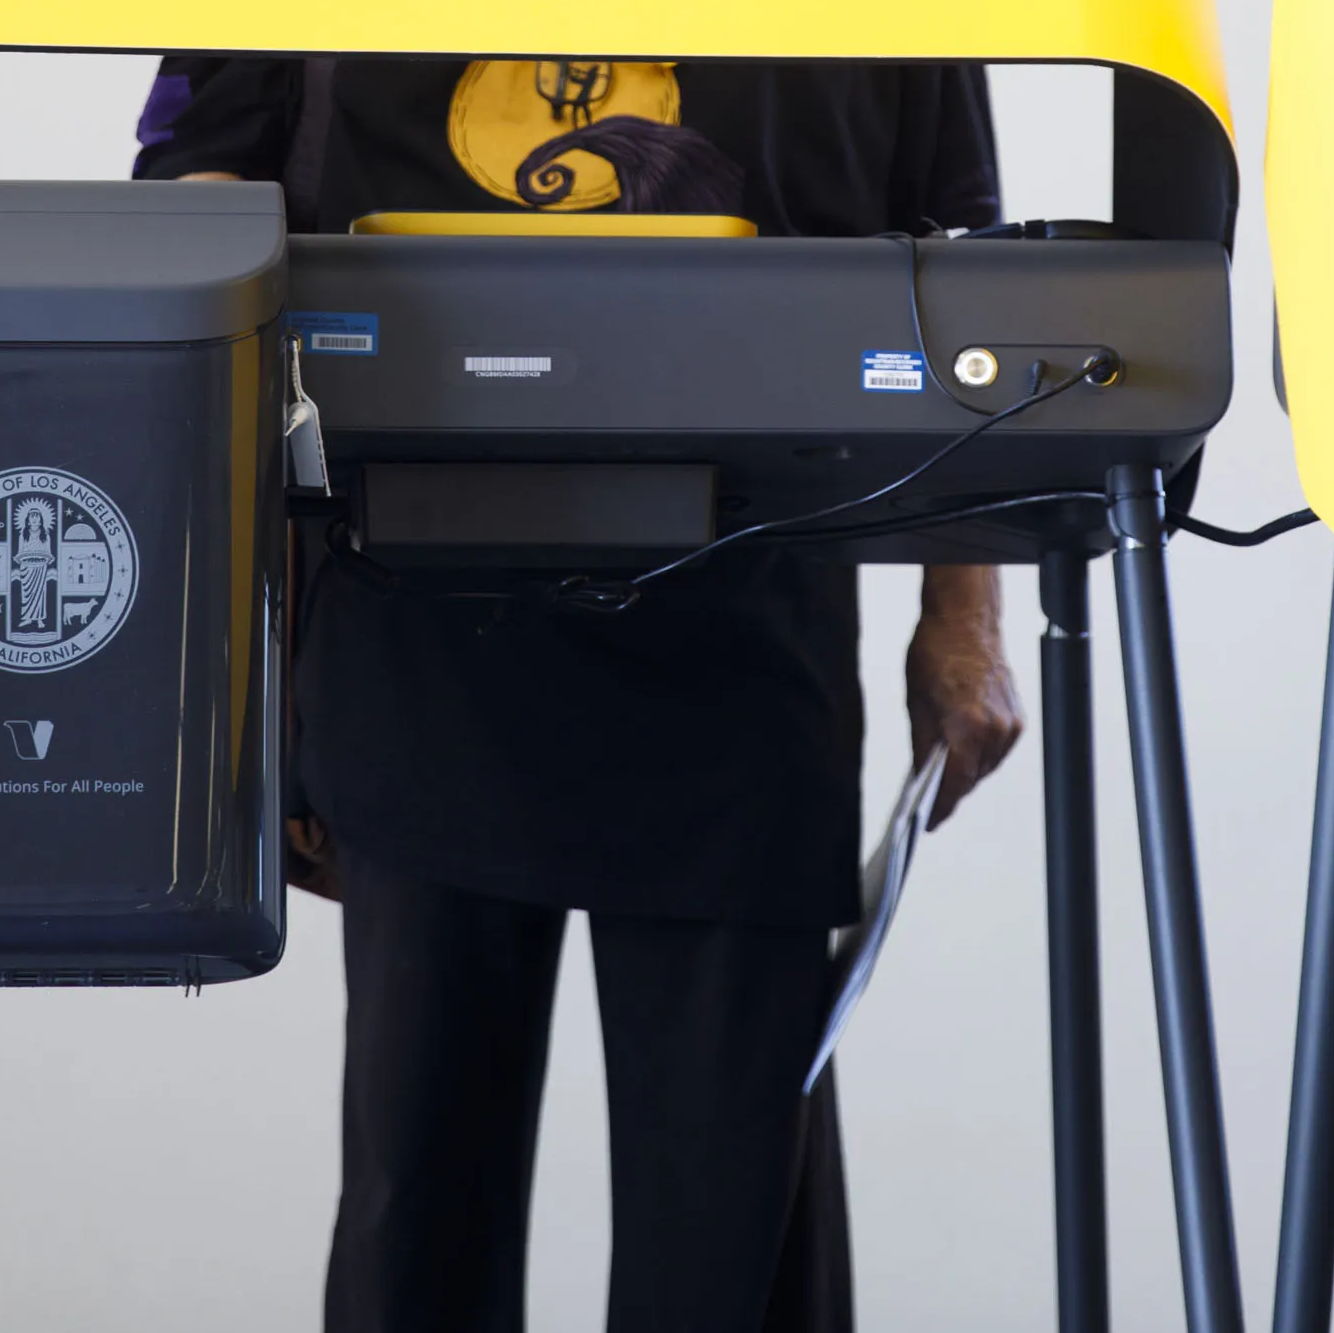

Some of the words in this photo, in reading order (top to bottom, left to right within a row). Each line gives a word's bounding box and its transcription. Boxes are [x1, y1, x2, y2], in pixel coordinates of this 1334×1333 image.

[2, 476, 24, 492] OF
[30, 475, 59, 491] LOS
[63, 483, 121, 537] ANGELES
[43, 780, 68, 794] For
[71, 779, 90, 793] All
[94, 779, 145, 797] People
